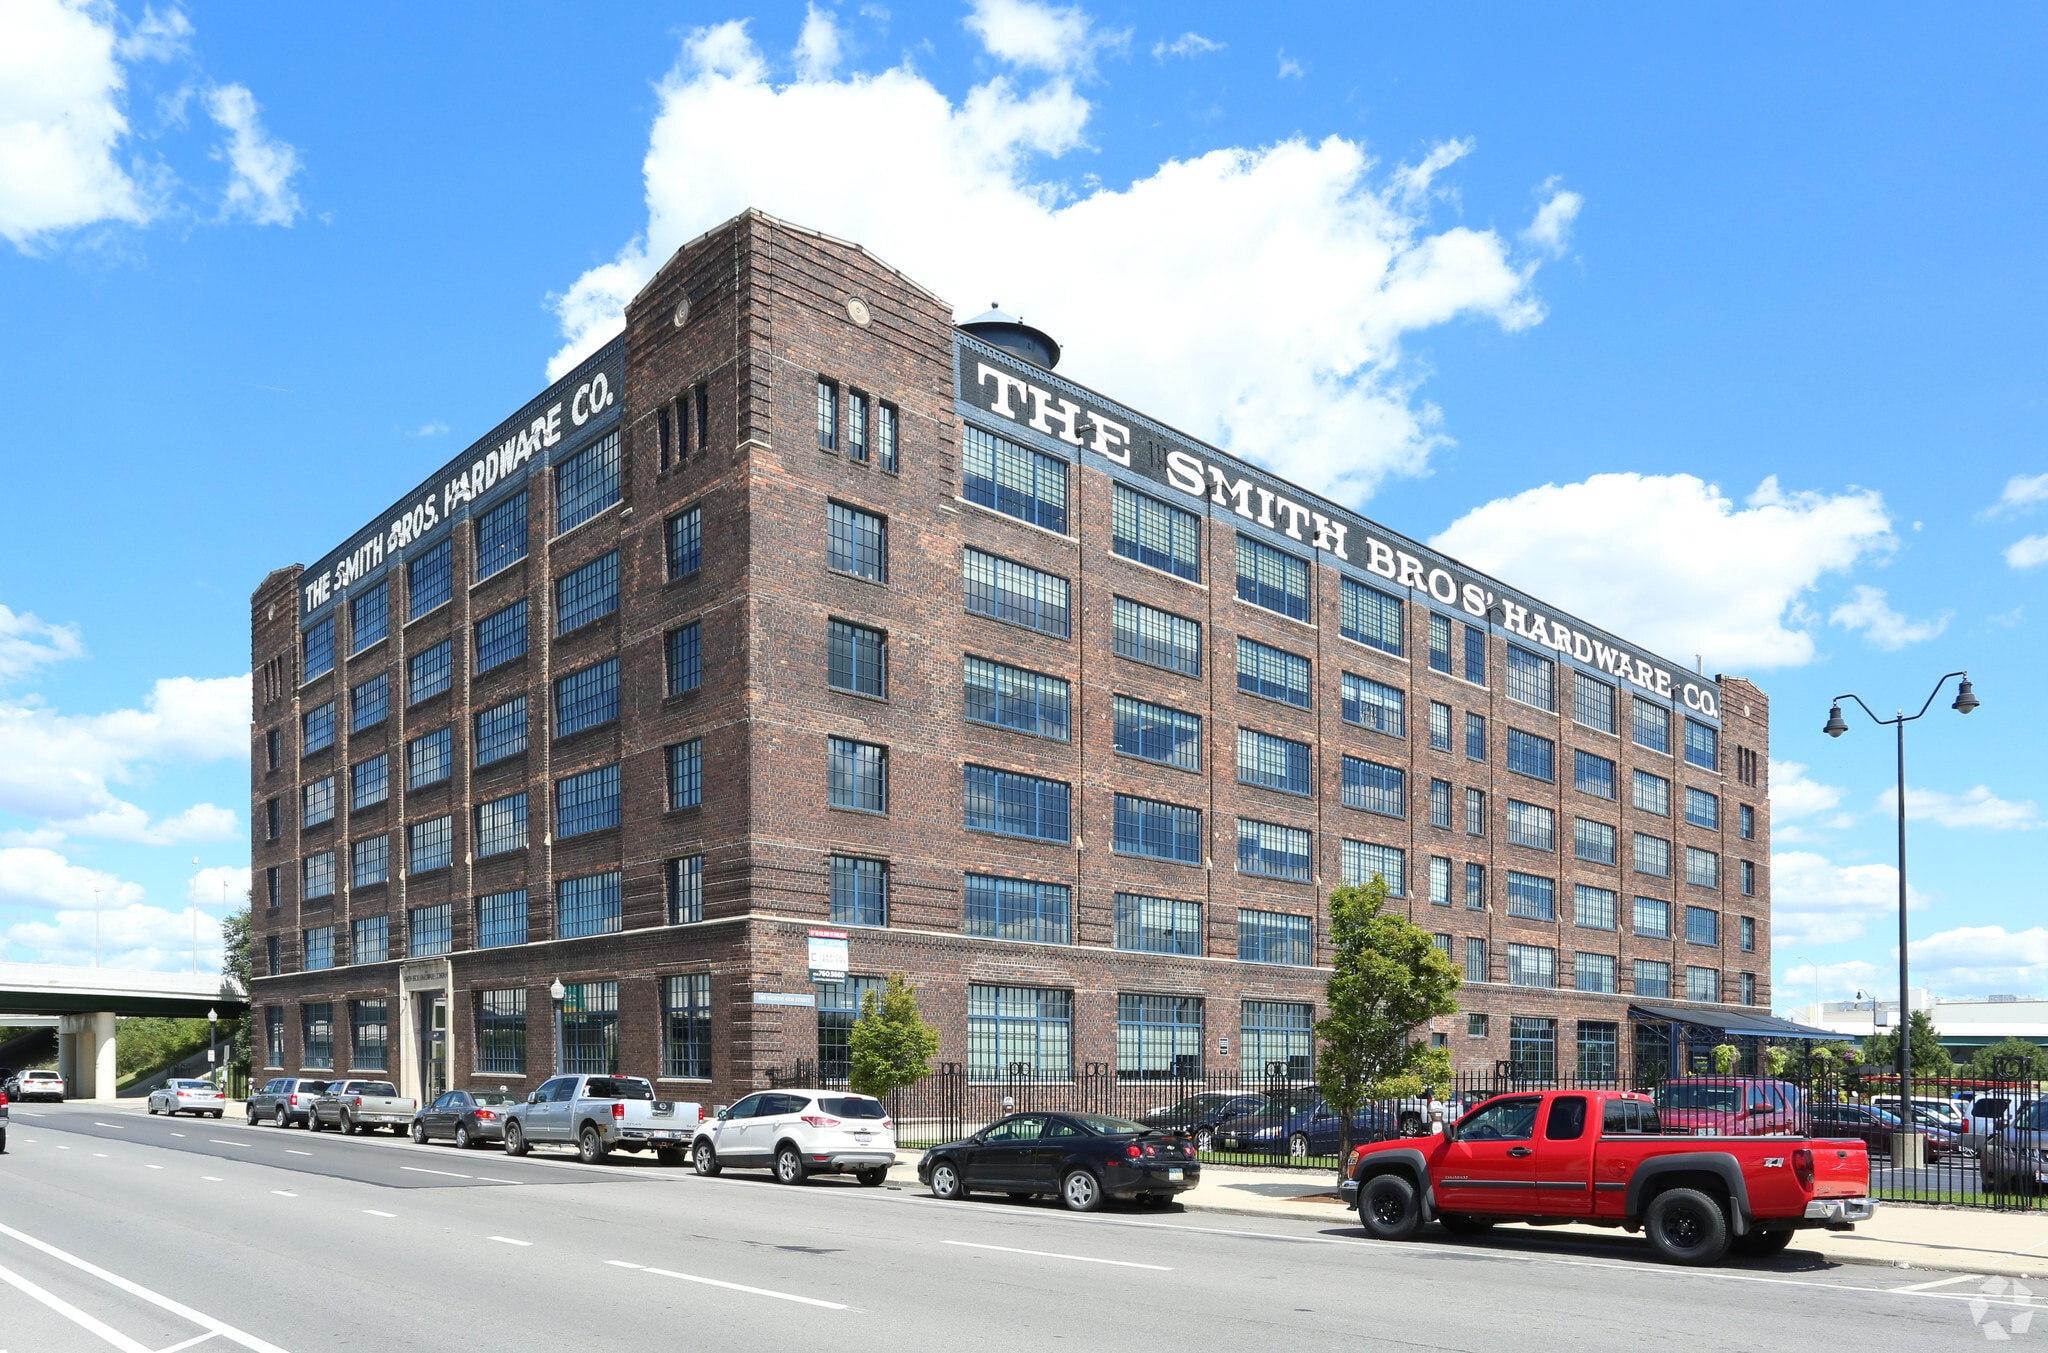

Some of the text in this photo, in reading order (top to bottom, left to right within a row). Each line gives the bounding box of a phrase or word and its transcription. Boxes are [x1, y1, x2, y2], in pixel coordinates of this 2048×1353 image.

[305, 372, 614, 613] THE SMITH BROS. HARDWARE CO.
[977, 362, 1719, 719] THE SMITH BROS' HARDWARE CO.
